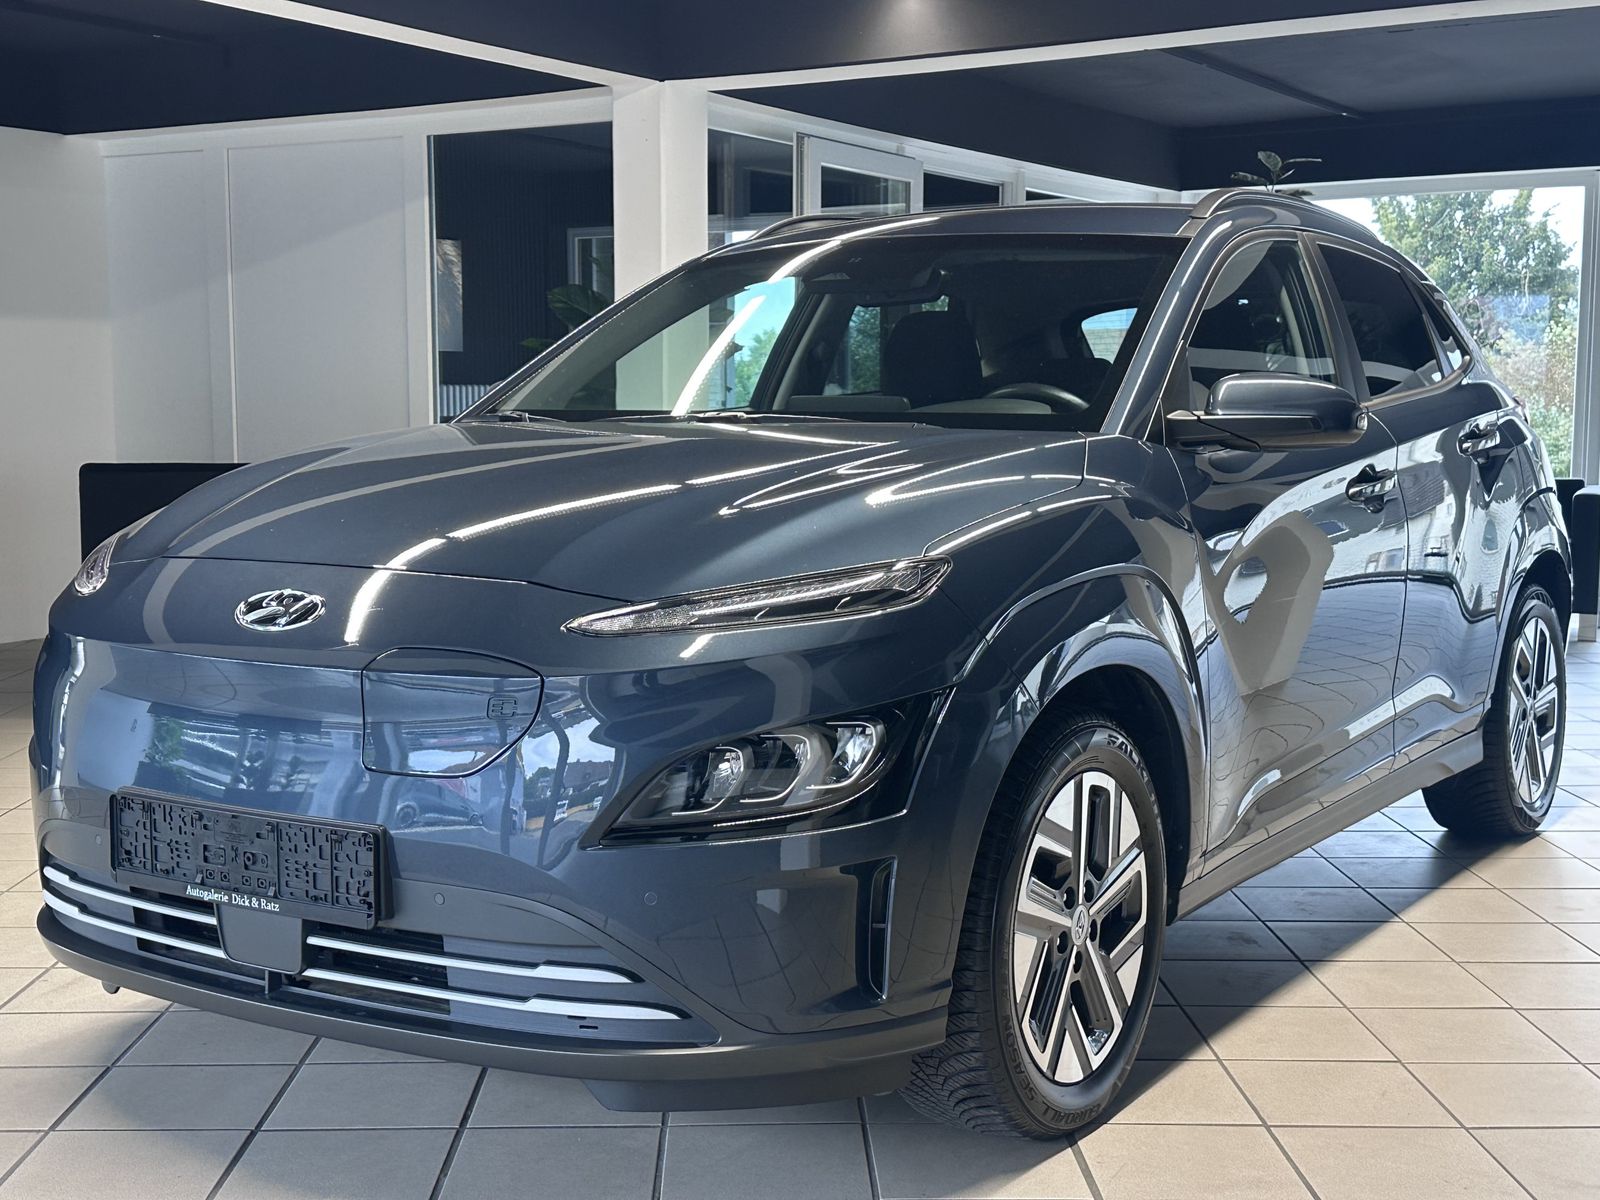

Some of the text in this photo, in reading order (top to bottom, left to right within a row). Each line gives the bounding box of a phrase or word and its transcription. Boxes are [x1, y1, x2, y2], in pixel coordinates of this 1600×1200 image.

[186, 884, 280, 912] Autogalerie Dick & Ratz
